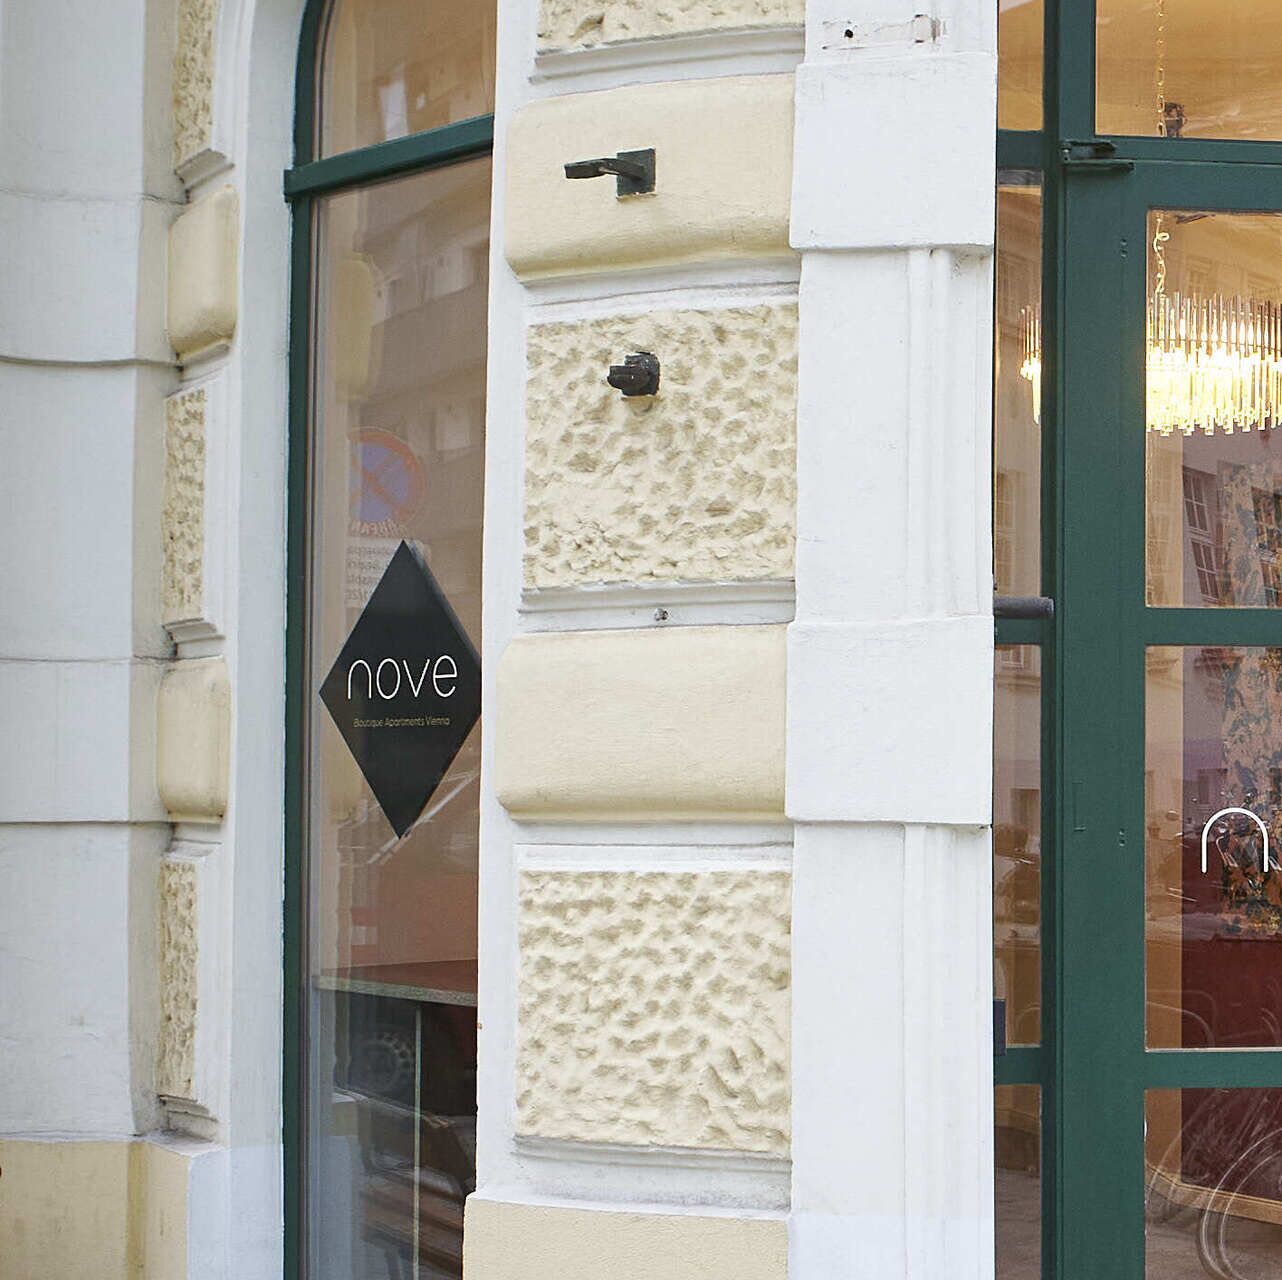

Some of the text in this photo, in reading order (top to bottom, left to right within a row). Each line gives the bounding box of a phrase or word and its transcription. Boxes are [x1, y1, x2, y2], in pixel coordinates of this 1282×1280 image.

[347, 655, 457, 699] nove
[353, 715, 450, 728] Boutique Apartments Vienna
